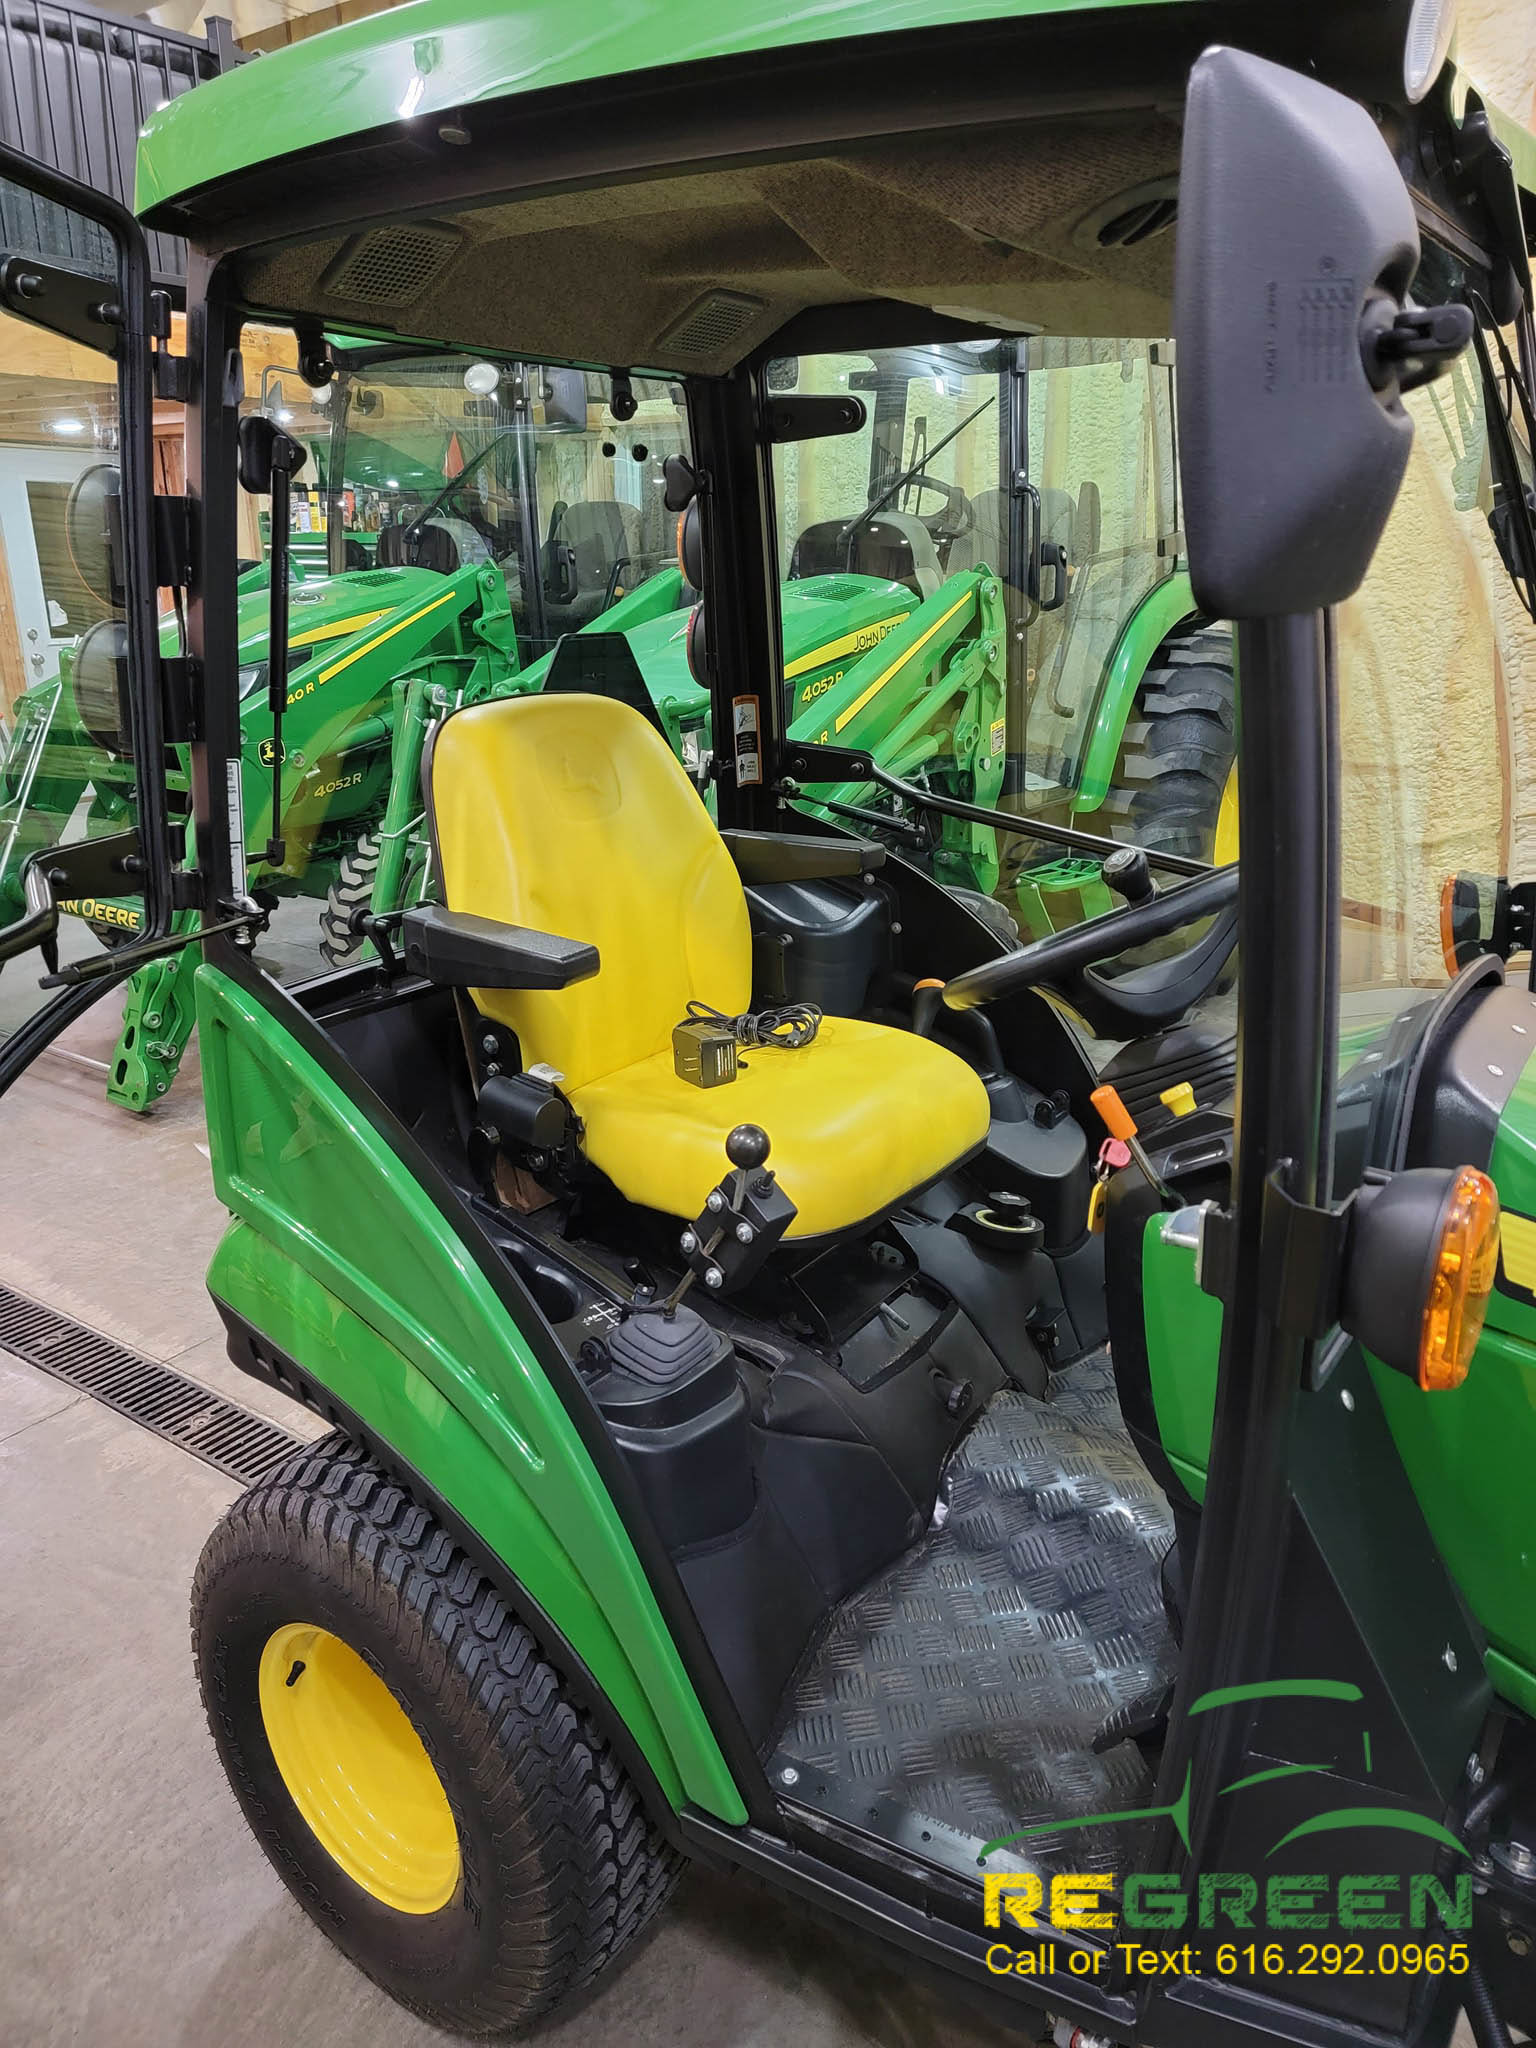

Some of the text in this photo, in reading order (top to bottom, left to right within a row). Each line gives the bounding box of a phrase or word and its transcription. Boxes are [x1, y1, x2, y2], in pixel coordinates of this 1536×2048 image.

[854, 631, 879, 651] JOHN
[314, 772, 362, 797] 4052R
[82, 898, 140, 930] DEERE
